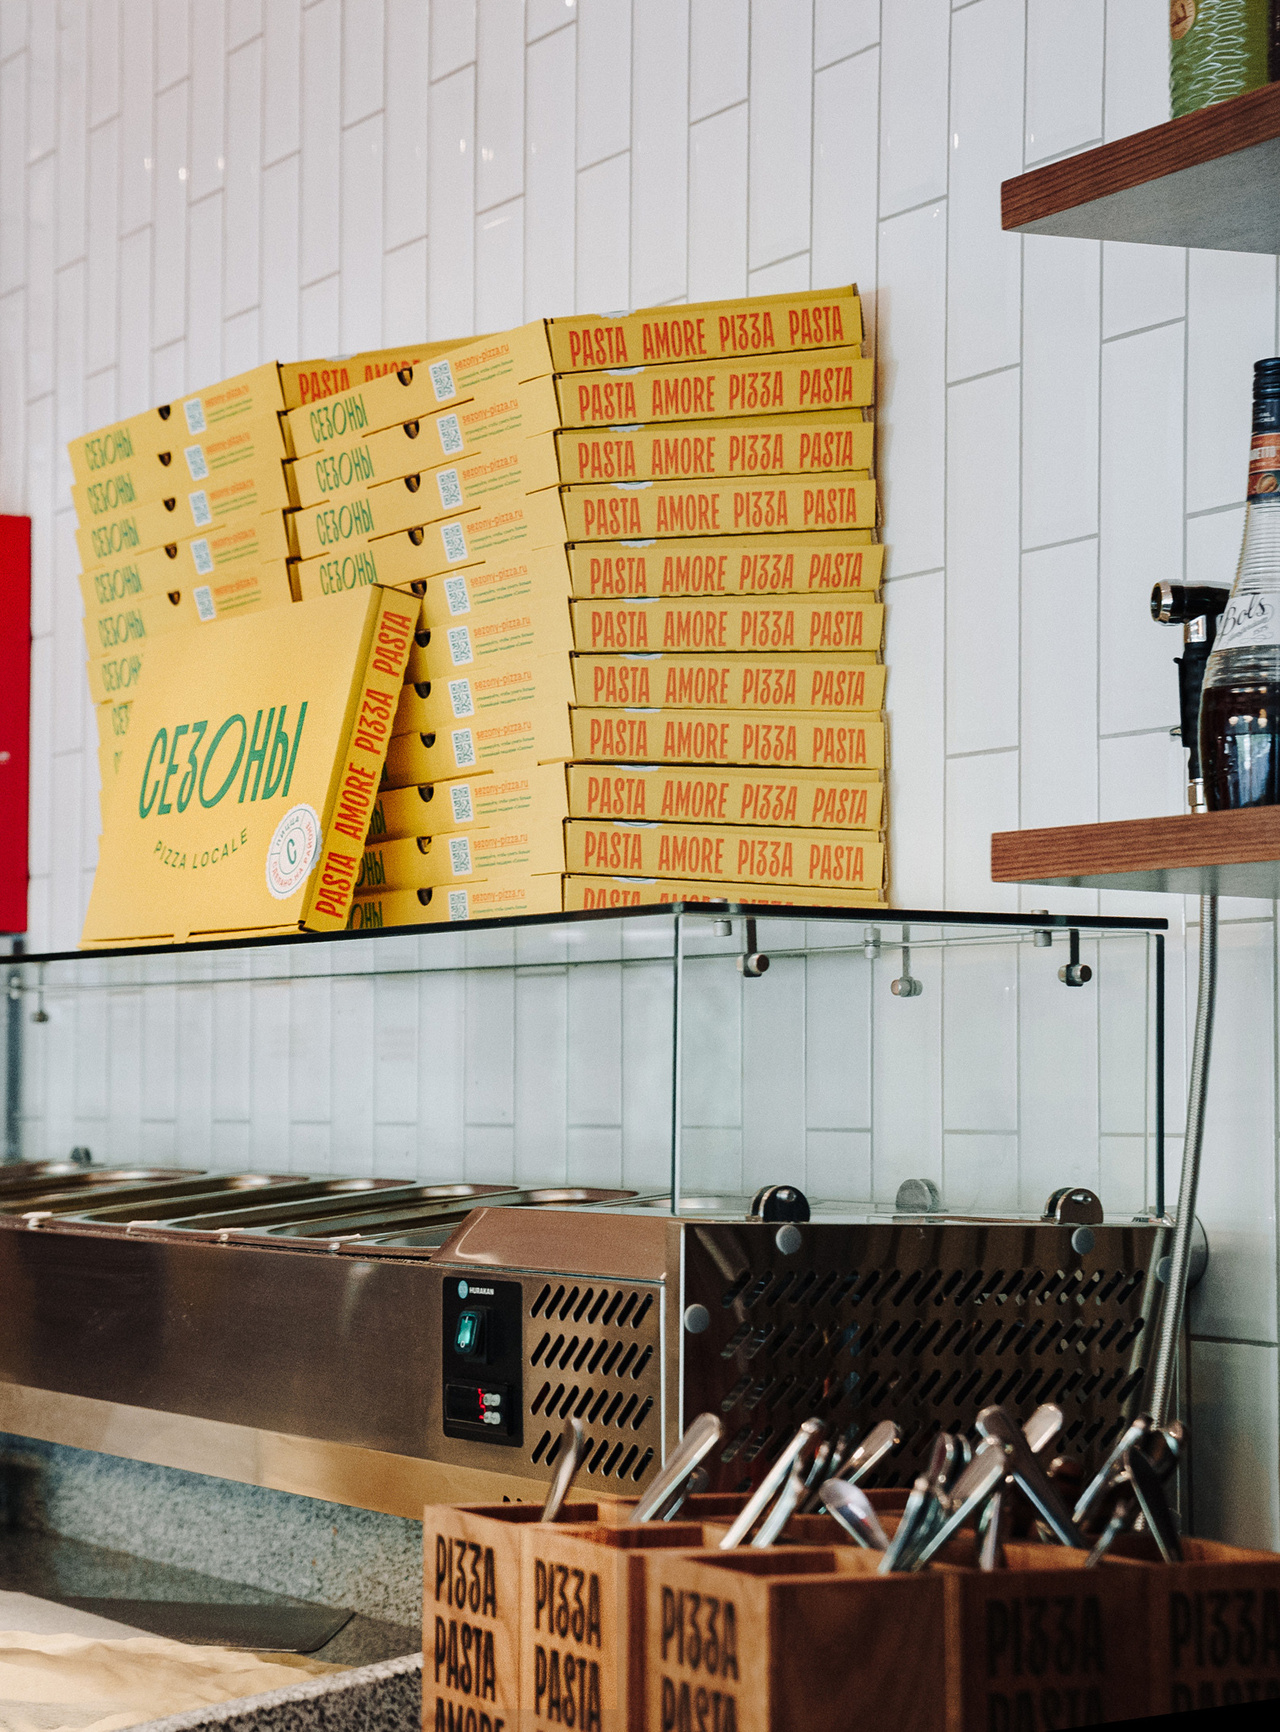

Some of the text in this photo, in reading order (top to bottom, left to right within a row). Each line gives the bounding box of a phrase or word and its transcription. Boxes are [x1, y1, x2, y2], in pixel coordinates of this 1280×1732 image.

[454, 344, 510, 372] sezony-pizza.ru
[568, 325, 629, 368] PASTA
[641, 317, 708, 361] AMORE
[787, 305, 845, 346] PASTA
[298, 367, 351, 405] PASTA
[577, 381, 637, 422] PASTA
[651, 375, 716, 417] AMORE
[798, 365, 853, 406] PASTA
[310, 393, 369, 443] СЕЗОНЫ
[462, 399, 518, 425] sezony-pizza.ru
[315, 444, 375, 493] СЕЗОНЫ
[462, 454, 518, 480] sezony-pizza.ru
[577, 440, 637, 479] PASTA
[651, 436, 716, 476] AMORE
[799, 430, 854, 469] PASTA
[315, 498, 375, 546] СЕЗОНЫ
[466, 509, 523, 534] sezony-pizza.ru
[583, 497, 642, 536] PASTA
[656, 493, 720, 532] AMORE
[803, 487, 857, 525] PASTA
[320, 550, 379, 596] СЕЗОНЫ
[470, 564, 527, 588] sezony-pizza.ru
[590, 556, 647, 595] PASTA
[661, 555, 728, 593] AMORE
[807, 552, 864, 589] PASTA
[372, 610, 412, 678] PASTA
[473, 615, 531, 638] sezony-pizza.ru
[591, 610, 648, 648] PASTA
[663, 610, 728, 647] AMORE
[809, 610, 864, 647] PASTA
[103, 655, 141, 692] СЕЗОН
[474, 671, 532, 691] sezony-pizza.ru
[593, 665, 650, 703] PASTA
[664, 667, 731, 704] AMORE
[810, 670, 866, 706] PASTA
[476, 721, 532, 741] sezony-pizza.ru
[590, 718, 648, 757] PASTA
[663, 721, 730, 760] AMORE
[812, 727, 867, 764] PASTA
[139, 700, 308, 820] СЕЗОНЫ
[334, 762, 377, 841] AMORE
[475, 779, 529, 797] sezony-pizza.ru
[587, 776, 646, 815] PASTA
[660, 779, 730, 819] AMORE
[811, 787, 868, 824] PASTA
[153, 828, 247, 869] PIZZA LOCALE
[584, 830, 643, 870] PASTA
[658, 834, 725, 874] AMORE
[808, 844, 864, 882] PASTA
[315, 851, 357, 920] PASTA
[435, 1615, 497, 1703] PASTA
[534, 1644, 603, 1732] PASTA
